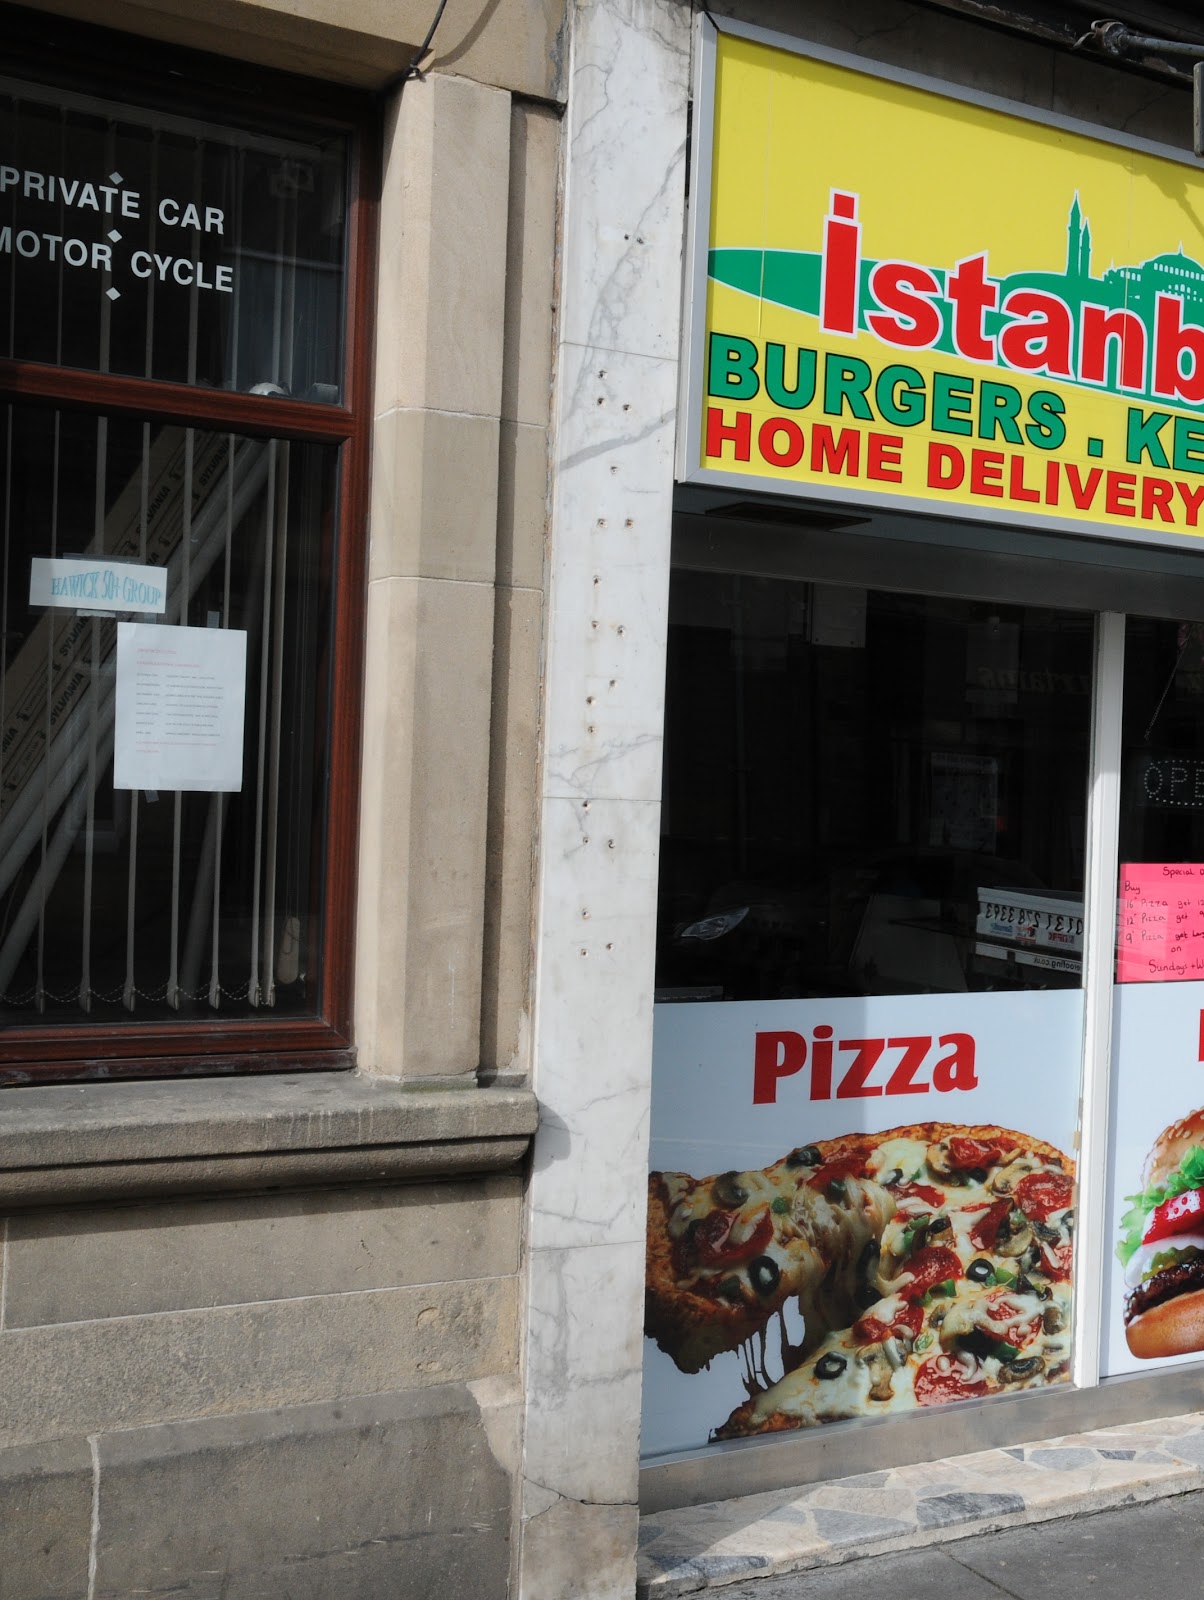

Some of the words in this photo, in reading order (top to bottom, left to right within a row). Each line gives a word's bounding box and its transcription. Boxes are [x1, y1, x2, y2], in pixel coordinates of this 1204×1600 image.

[0, 165, 140, 219] PRIVATE
[158, 198, 225, 235] CAR
[130, 250, 234, 293] CYCLE
[708, 331, 1067, 450] BURGERS
[705, 407, 904, 484] HOME
[51, 570, 100, 599] HAWICK
[122, 576, 162, 606] GROUP
[1124, 880, 1141, 894] Buy
[1178, 899, 1191, 909] get
[1176, 913, 1189, 923] get
[1171, 945, 1182, 953] on
[1175, 931, 1188, 941] get
[1148, 959, 1188, 975] Sundays
[752, 1024, 979, 1105] Pizza
